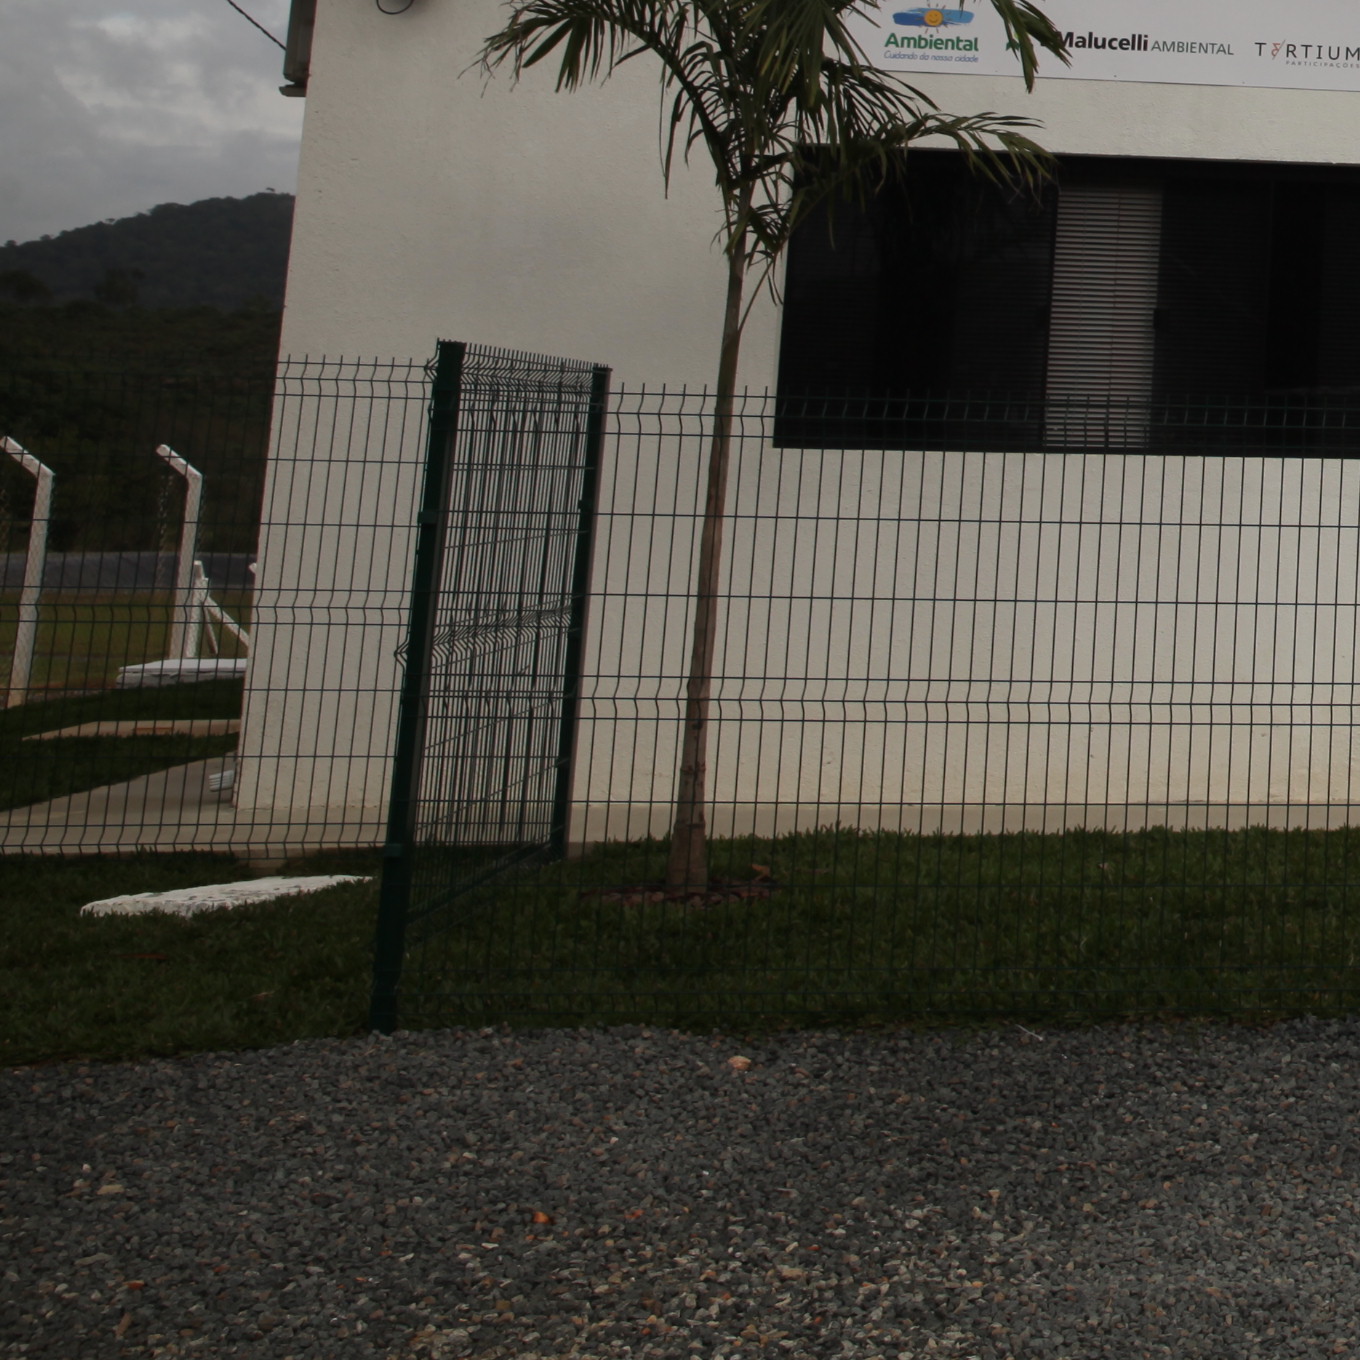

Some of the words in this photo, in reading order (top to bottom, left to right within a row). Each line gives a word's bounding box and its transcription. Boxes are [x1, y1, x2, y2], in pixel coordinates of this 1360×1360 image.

[884, 32, 979, 52] Ambiental
[1056, 31, 1148, 52] Malucelli
[1150, 39, 1235, 56] AMBIENTAL
[884, 50, 918, 60] Cuidando
[919, 52, 929, 61] da
[954, 53, 979, 63] cidade
[1286, 60, 1360, 69] PARTICIPAÇÕES
